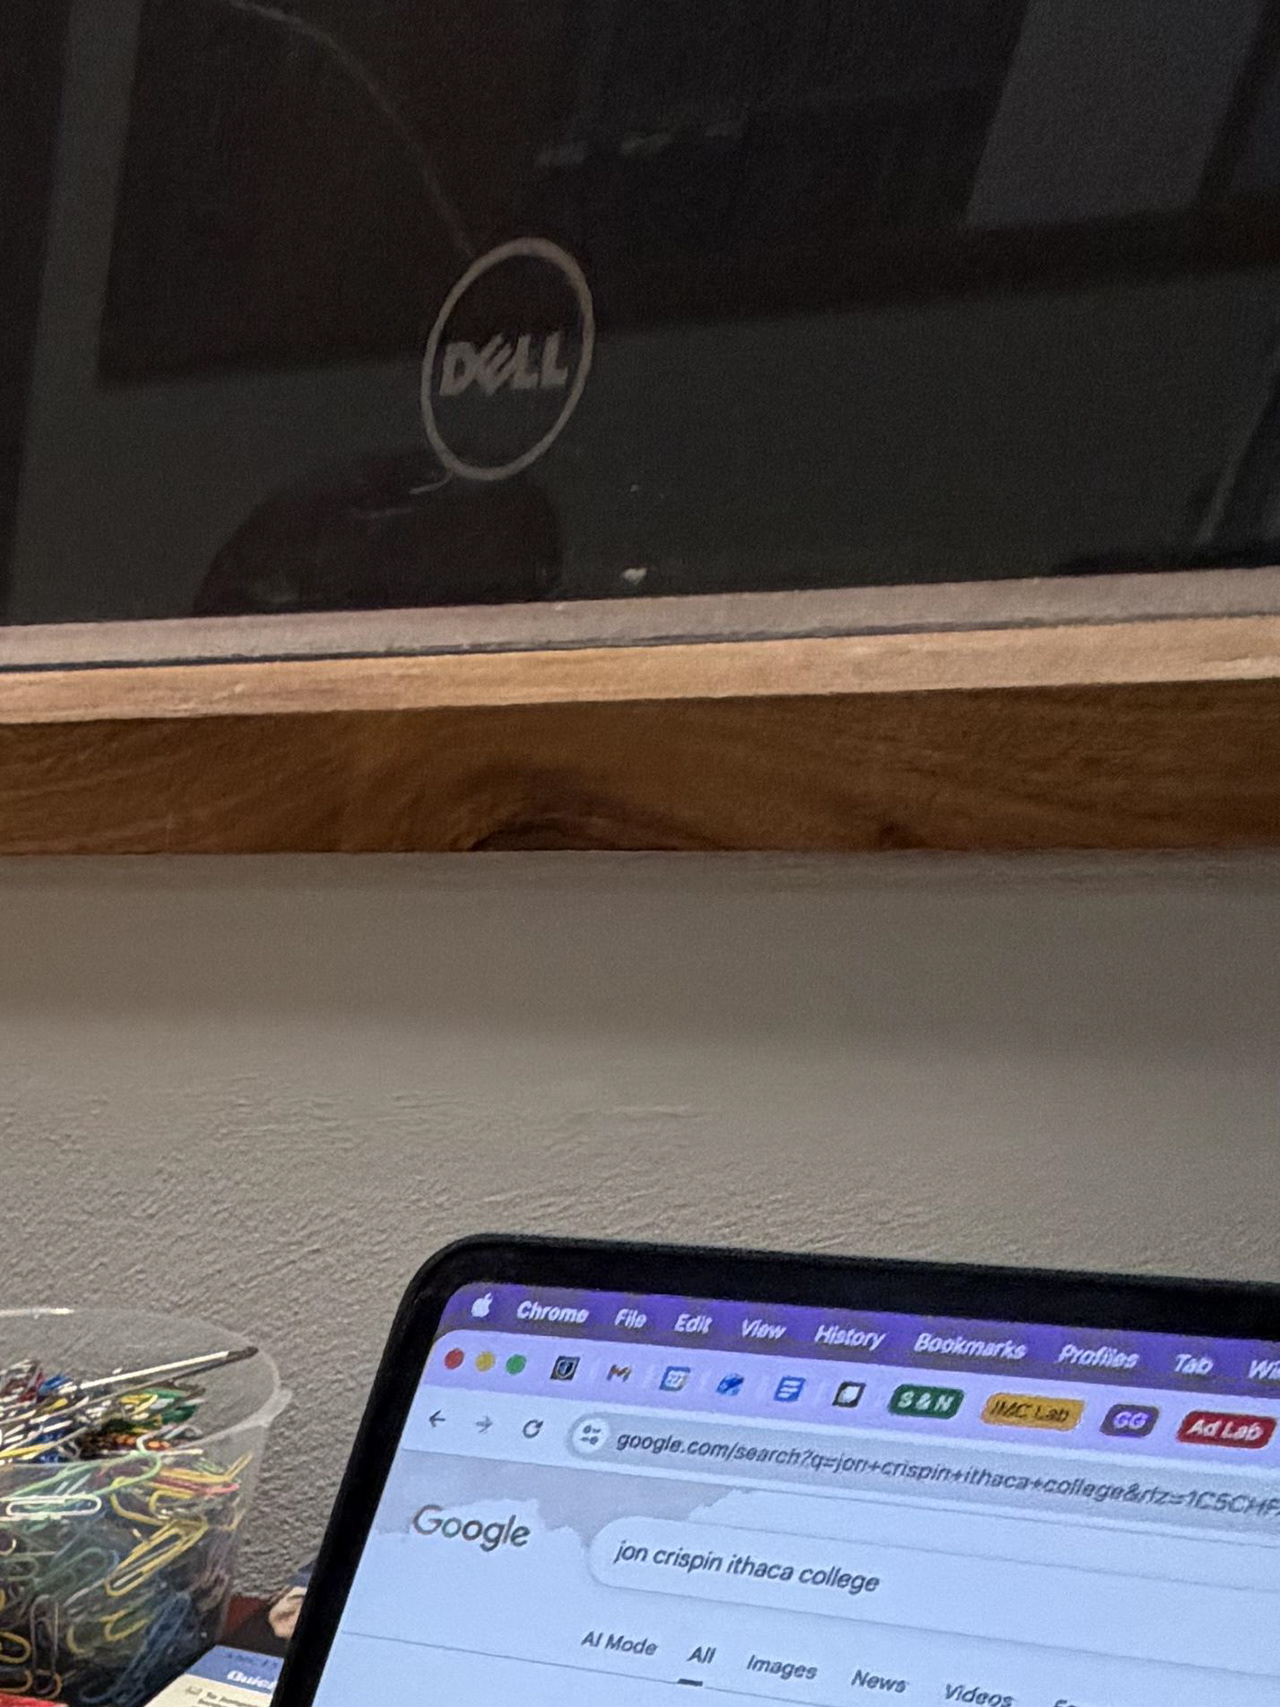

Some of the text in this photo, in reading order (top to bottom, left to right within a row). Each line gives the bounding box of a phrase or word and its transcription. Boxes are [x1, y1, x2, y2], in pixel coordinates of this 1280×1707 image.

[440, 331, 569, 397] DELL
[516, 1301, 1214, 1375] Chrome File Edit View History Bookmarks Profiles Tab
[1187, 1420, 1264, 1441] Ad Lab
[412, 1505, 531, 1552] Google
[612, 1540, 881, 1596] jon crispin ithaca college
[580, 1631, 604, 1648] AI
[605, 1634, 659, 1656] Mode
[686, 1646, 717, 1665] All
[746, 1654, 819, 1681] Images
[851, 1670, 911, 1694] News
